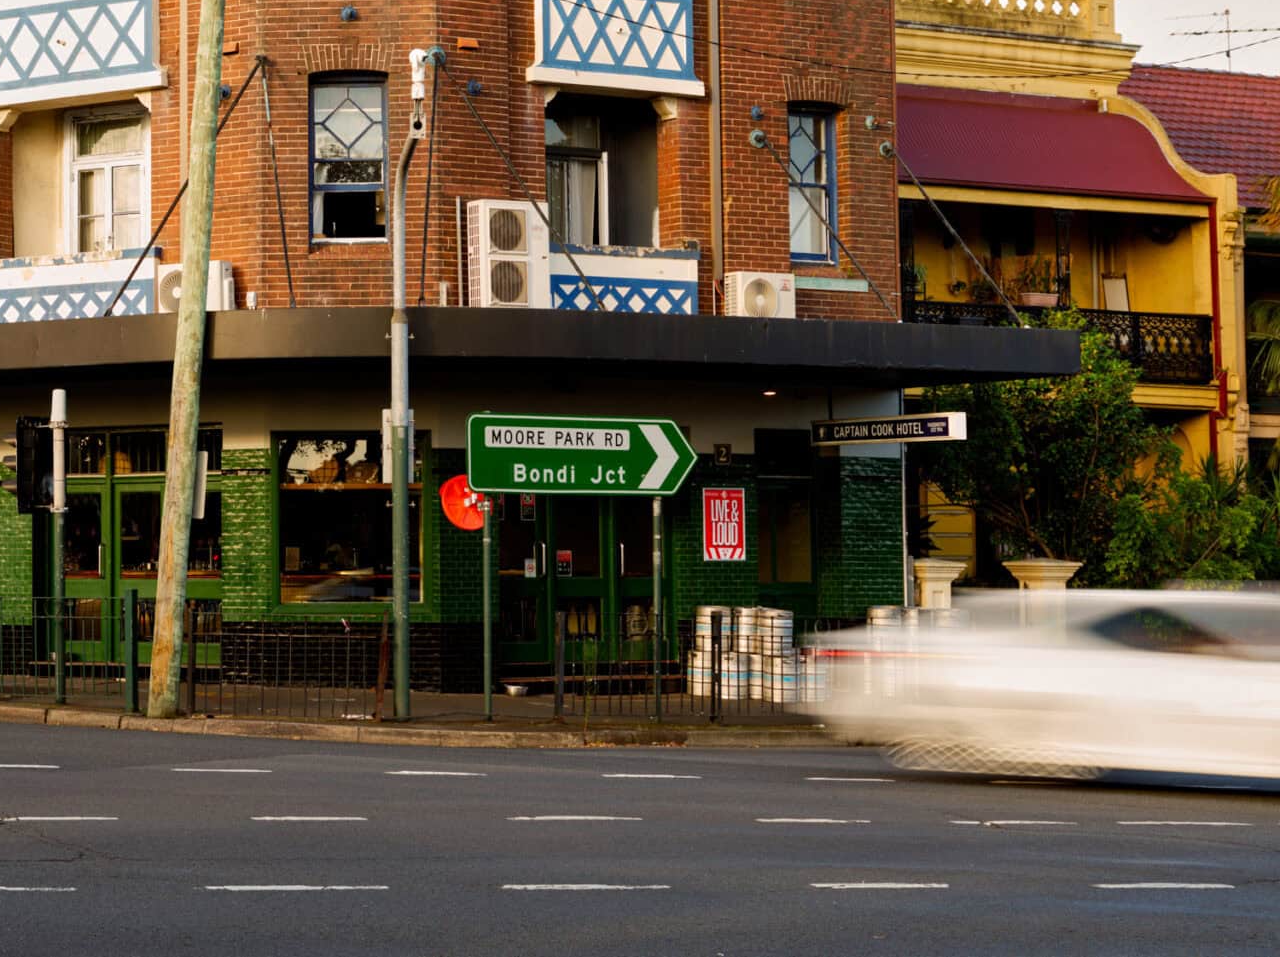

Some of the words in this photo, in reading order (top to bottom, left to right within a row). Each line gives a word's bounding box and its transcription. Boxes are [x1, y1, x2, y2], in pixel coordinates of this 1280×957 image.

[491, 429, 545, 446] MOORE
[554, 431, 595, 447] PARK
[604, 432, 624, 447] RD
[833, 425, 869, 439] CAPTAIN
[871, 423, 894, 437] COOK
[896, 421, 924, 435] HOTEL
[513, 463, 576, 484] Bondi
[590, 465, 627, 485] Jct
[710, 499, 730, 522] LIVE
[731, 499, 740, 522] &
[712, 522, 738, 546] LOUD
